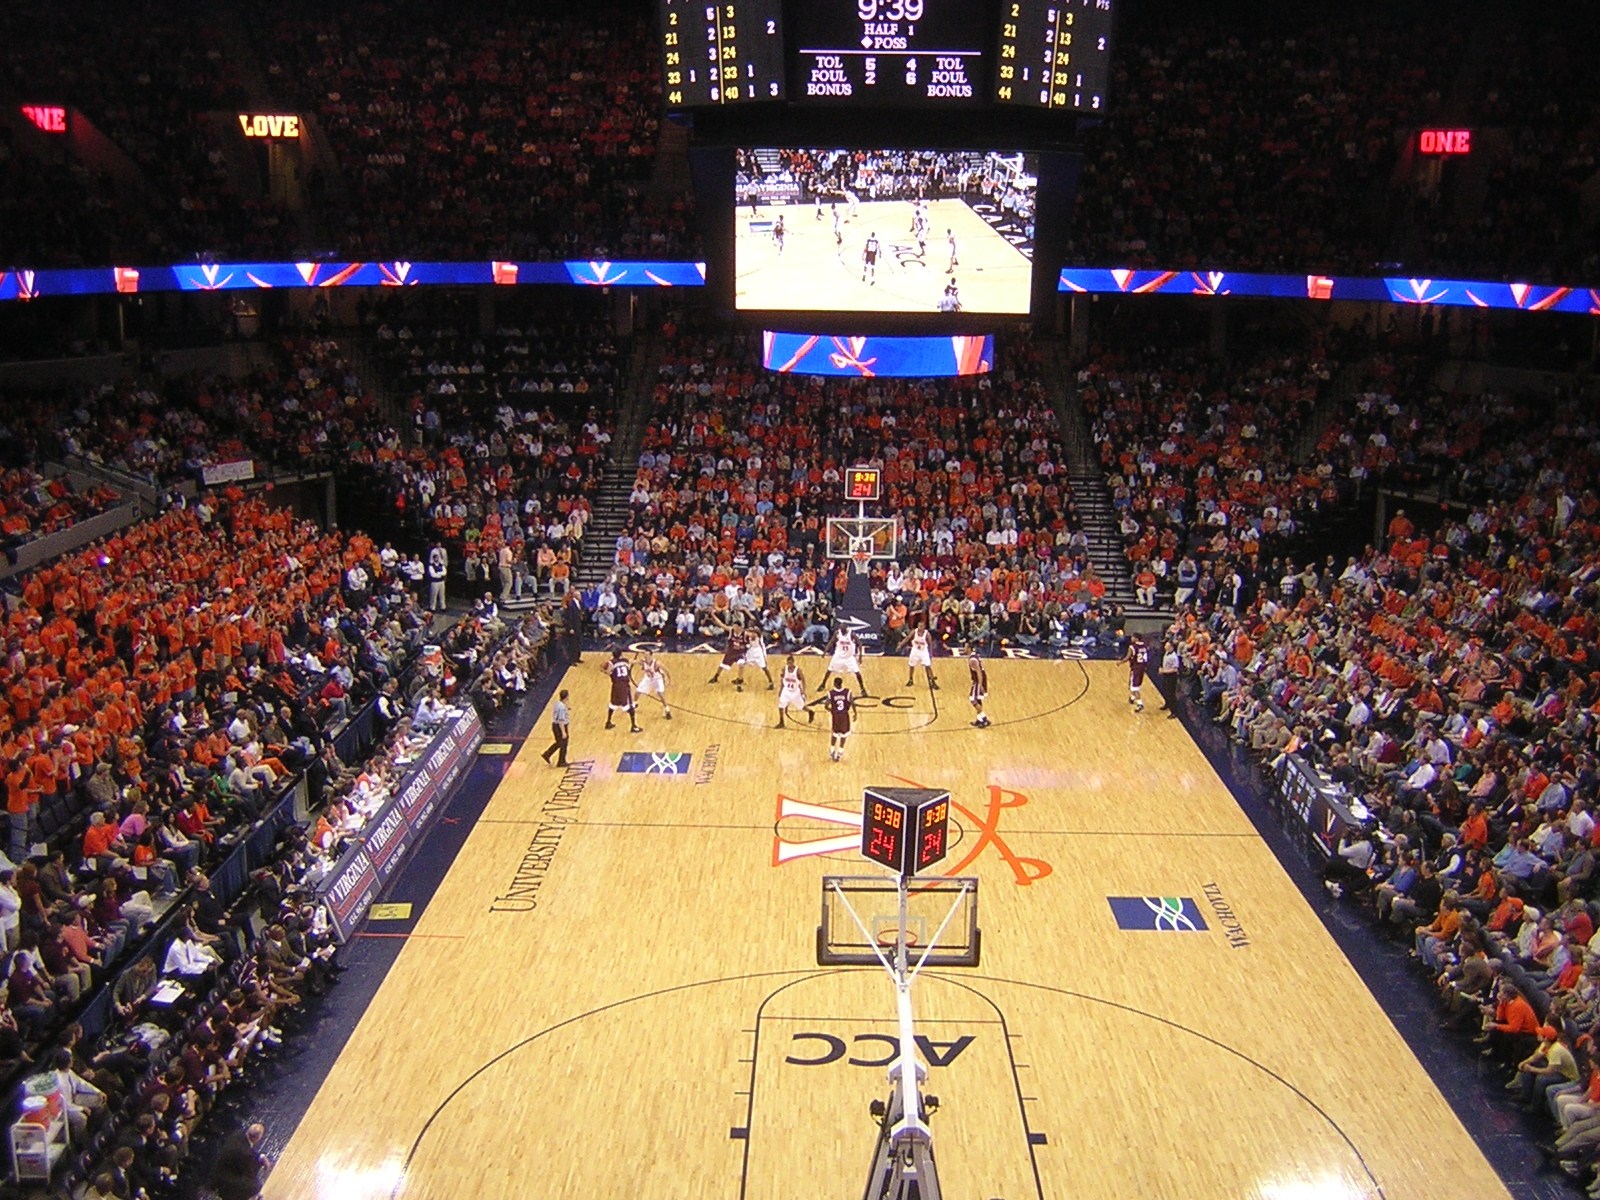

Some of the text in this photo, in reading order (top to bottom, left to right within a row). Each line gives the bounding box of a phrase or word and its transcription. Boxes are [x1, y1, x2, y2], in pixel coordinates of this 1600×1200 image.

[669, 7, 715, 26] 2 5
[726, 5, 735, 19] 3
[858, 0, 924, 21] 9:39
[1011, 4, 1056, 23] 2 5
[1065, 12, 1074, 26] 3
[665, 27, 716, 46] 21 2
[722, 20, 776, 39] 13 2
[864, 23, 915, 36] HALF 1
[1003, 23, 1054, 43] 21 2
[874, 37, 908, 49] POSS
[1059, 32, 1106, 51] 13 2
[666, 47, 717, 66] 24 3
[722, 46, 737, 60] 24
[1001, 44, 1052, 63] 24 3
[1056, 52, 1070, 66] 24
[724, 63, 755, 80] 33 1
[815, 56, 876, 71] TOL 5
[906, 57, 964, 71] 4 TOL
[667, 67, 718, 85] 33 1 2
[811, 70, 876, 85] FOUL 2
[906, 71, 968, 85] 6 FOUL
[1000, 65, 1051, 83] 33 1 2
[1054, 72, 1082, 87] 33 1
[668, 87, 719, 105] 44 6
[725, 82, 779, 100] 40 1 3
[807, 83, 853, 96] BONUS
[927, 85, 973, 98] BONUS
[998, 85, 1049, 104] 44 6
[1053, 92, 1100, 109] 40 1 3
[239, 114, 299, 137] LOVE
[1420, 131, 1470, 153] ONE
[852, 483, 872, 497] 24
[1136, 653, 1149, 664] 24
[616, 666, 628, 678] 13
[836, 700, 845, 711] 3
[432, 736, 457, 772] VIRGINIA
[403, 769, 432, 808] VIRGINIA
[873, 803, 902, 829] 9:38
[925, 802, 948, 828] 9:38
[371, 807, 403, 851] VIRGINIA
[870, 827, 896, 861] 24
[922, 828, 943, 862] 24
[333, 851, 370, 900] VIRGINIA
[1202, 881, 1252, 950] WACHOVIA
[785, 1032, 977, 1068] ACC
